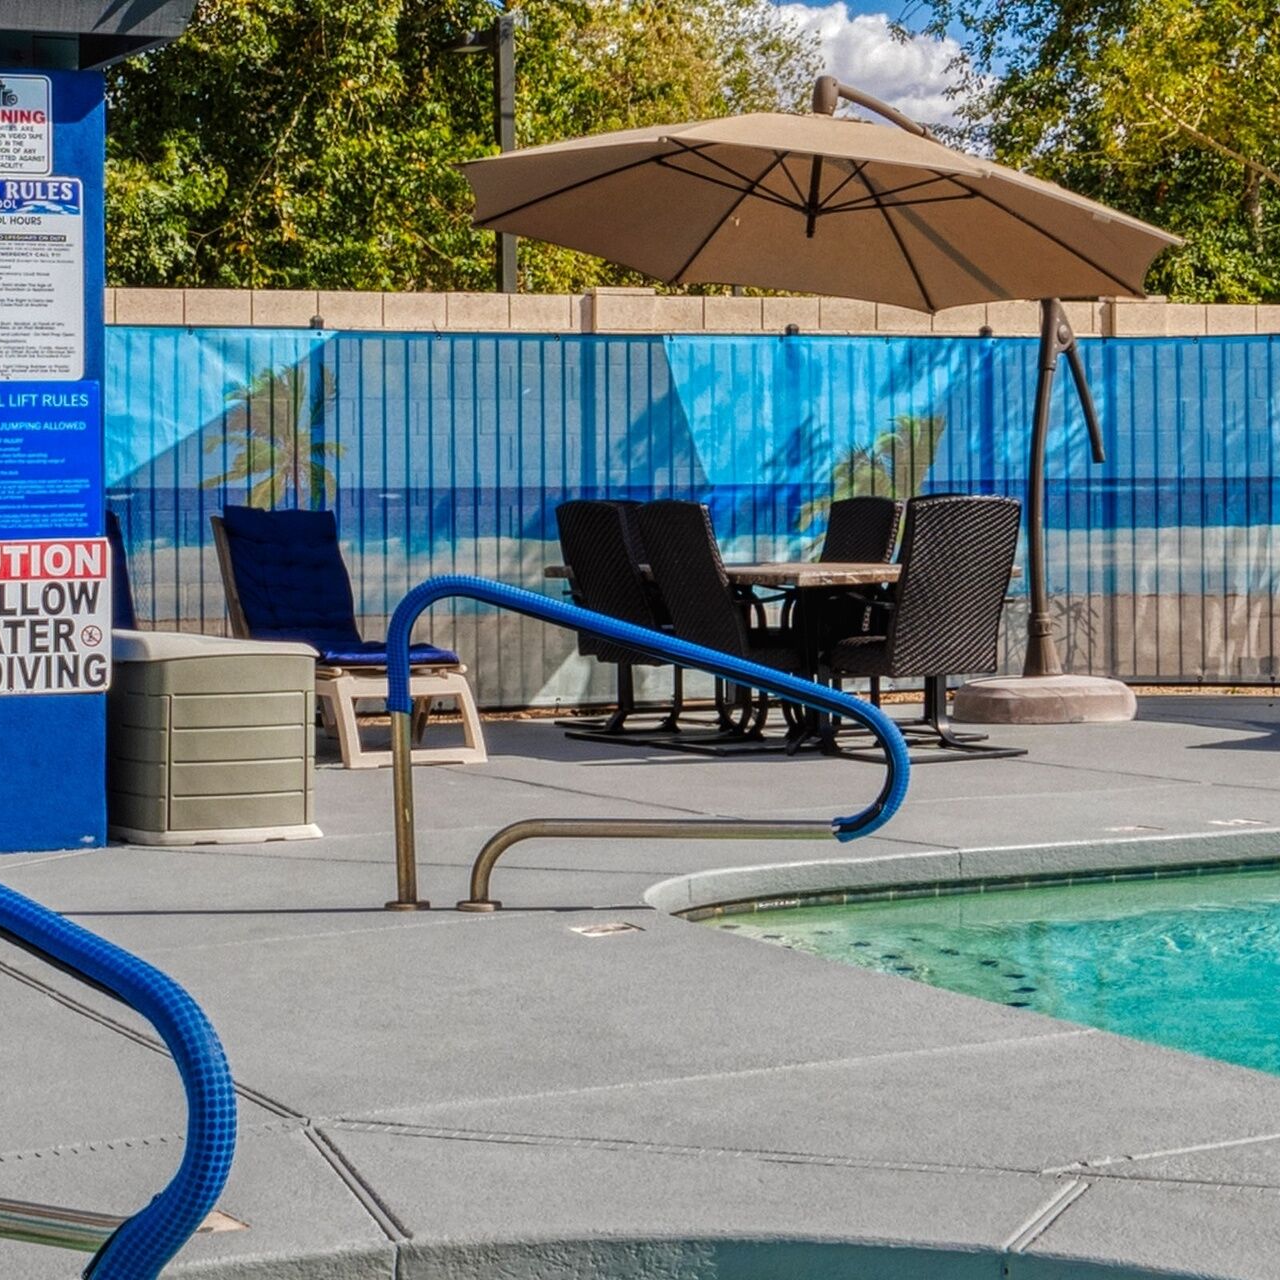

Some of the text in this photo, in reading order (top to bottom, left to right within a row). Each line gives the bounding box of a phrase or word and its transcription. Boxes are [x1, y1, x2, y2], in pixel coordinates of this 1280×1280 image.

[5, 181, 73, 201] RULES
[10, 216, 42, 225] HOURS
[9, 394, 38, 407] LIFT
[42, 394, 89, 407] RULES
[0, 422, 41, 431] JUMPING
[43, 421, 87, 431] ALLOWED
